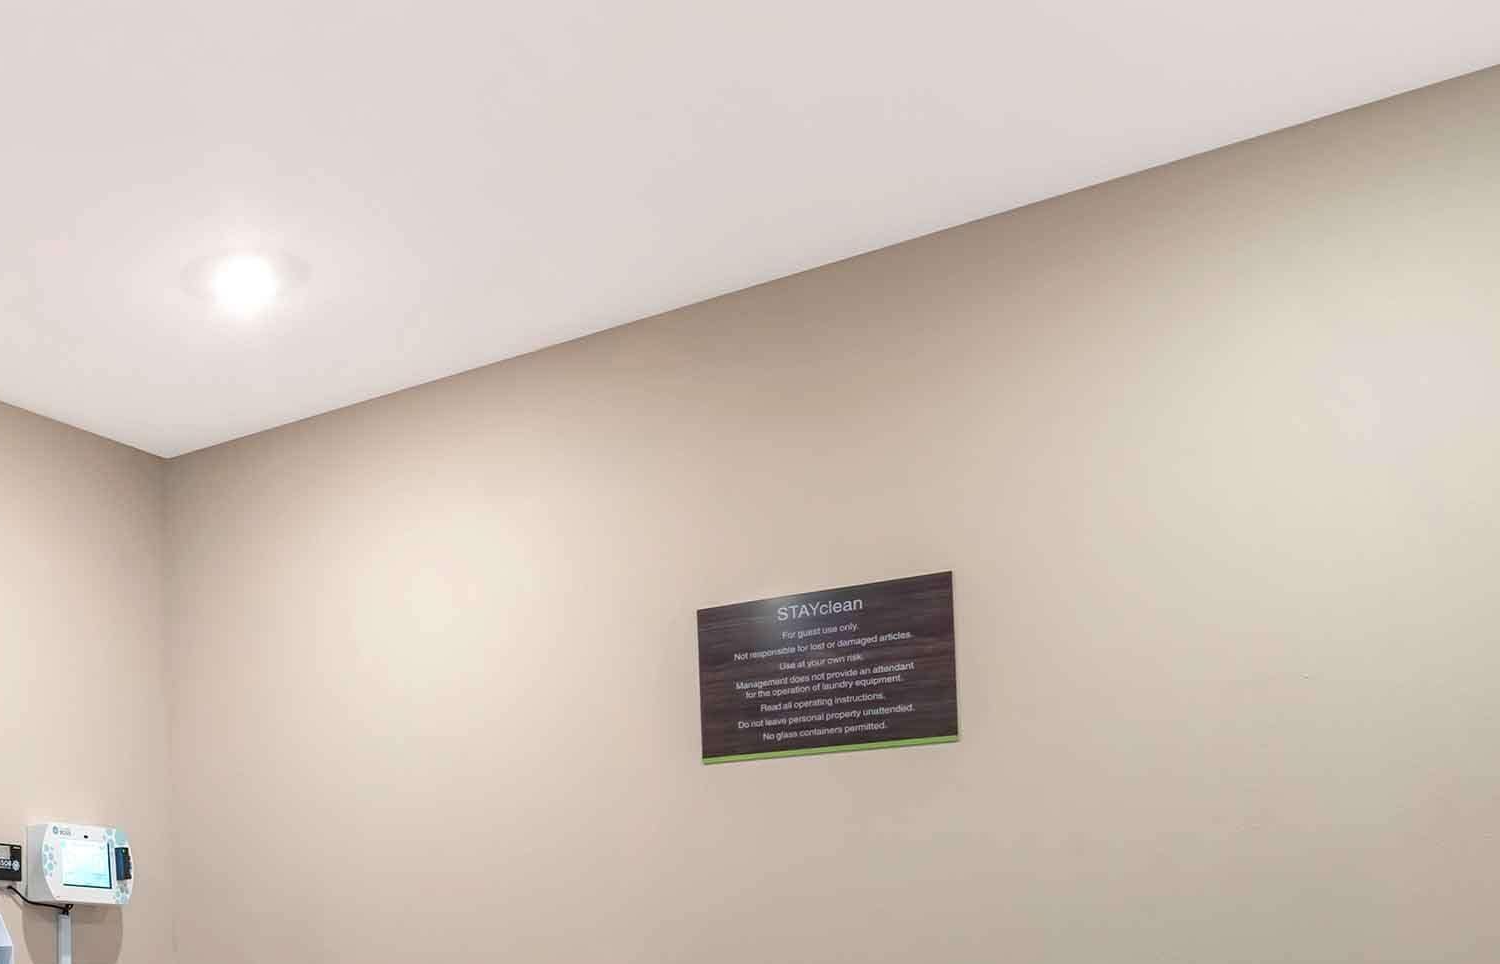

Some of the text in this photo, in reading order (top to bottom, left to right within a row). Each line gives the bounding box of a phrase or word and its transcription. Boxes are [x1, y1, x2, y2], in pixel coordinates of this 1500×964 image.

[777, 599, 863, 621] STAYclean
[782, 622, 859, 640] For guest use only.
[734, 631, 913, 661] Not responsible for lost or damaged articles.
[780, 662, 796, 670] Use
[798, 660, 806, 668] at
[807, 658, 826, 668] your
[827, 656, 845, 664] own
[736, 676, 788, 690] Management
[789, 674, 810, 684] does
[811, 672, 826, 681] not
[826, 668, 858, 680] provide
[872, 662, 914, 674] attendant
[746, 690, 756, 699] for
[758, 688, 770, 697] the
[772, 685, 810, 696] operation
[812, 683, 820, 692] of
[822, 680, 854, 690] laundry
[760, 692, 885, 712] Read all operating instructions.
[751, 719, 764, 727] not
[765, 716, 786, 726] leave
[788, 713, 824, 724] personal
[826, 709, 861, 720] property
[863, 704, 915, 716] unattended.
[763, 721, 888, 740] No glass containers permitted.
